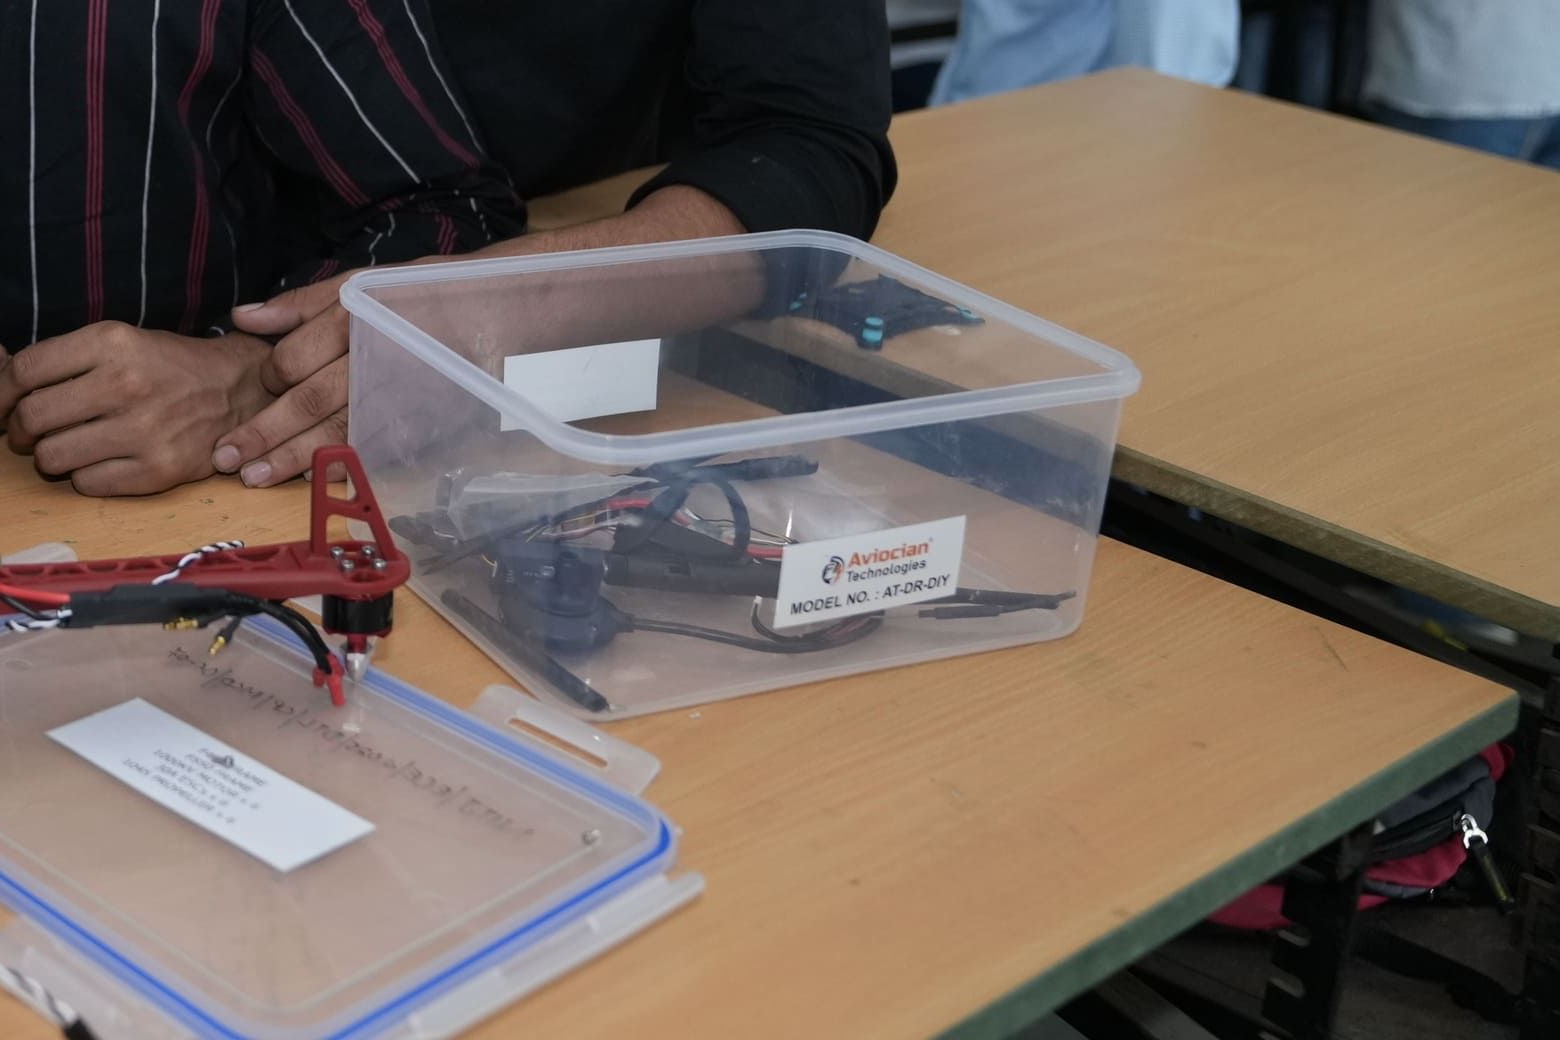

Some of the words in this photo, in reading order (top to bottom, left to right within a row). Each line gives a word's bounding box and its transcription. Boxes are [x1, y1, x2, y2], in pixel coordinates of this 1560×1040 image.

[848, 541, 929, 568] Aviocian
[847, 558, 927, 583] Technologies
[790, 596, 842, 615] MODEL
[882, 573, 951, 600] AT-DR-DIY
